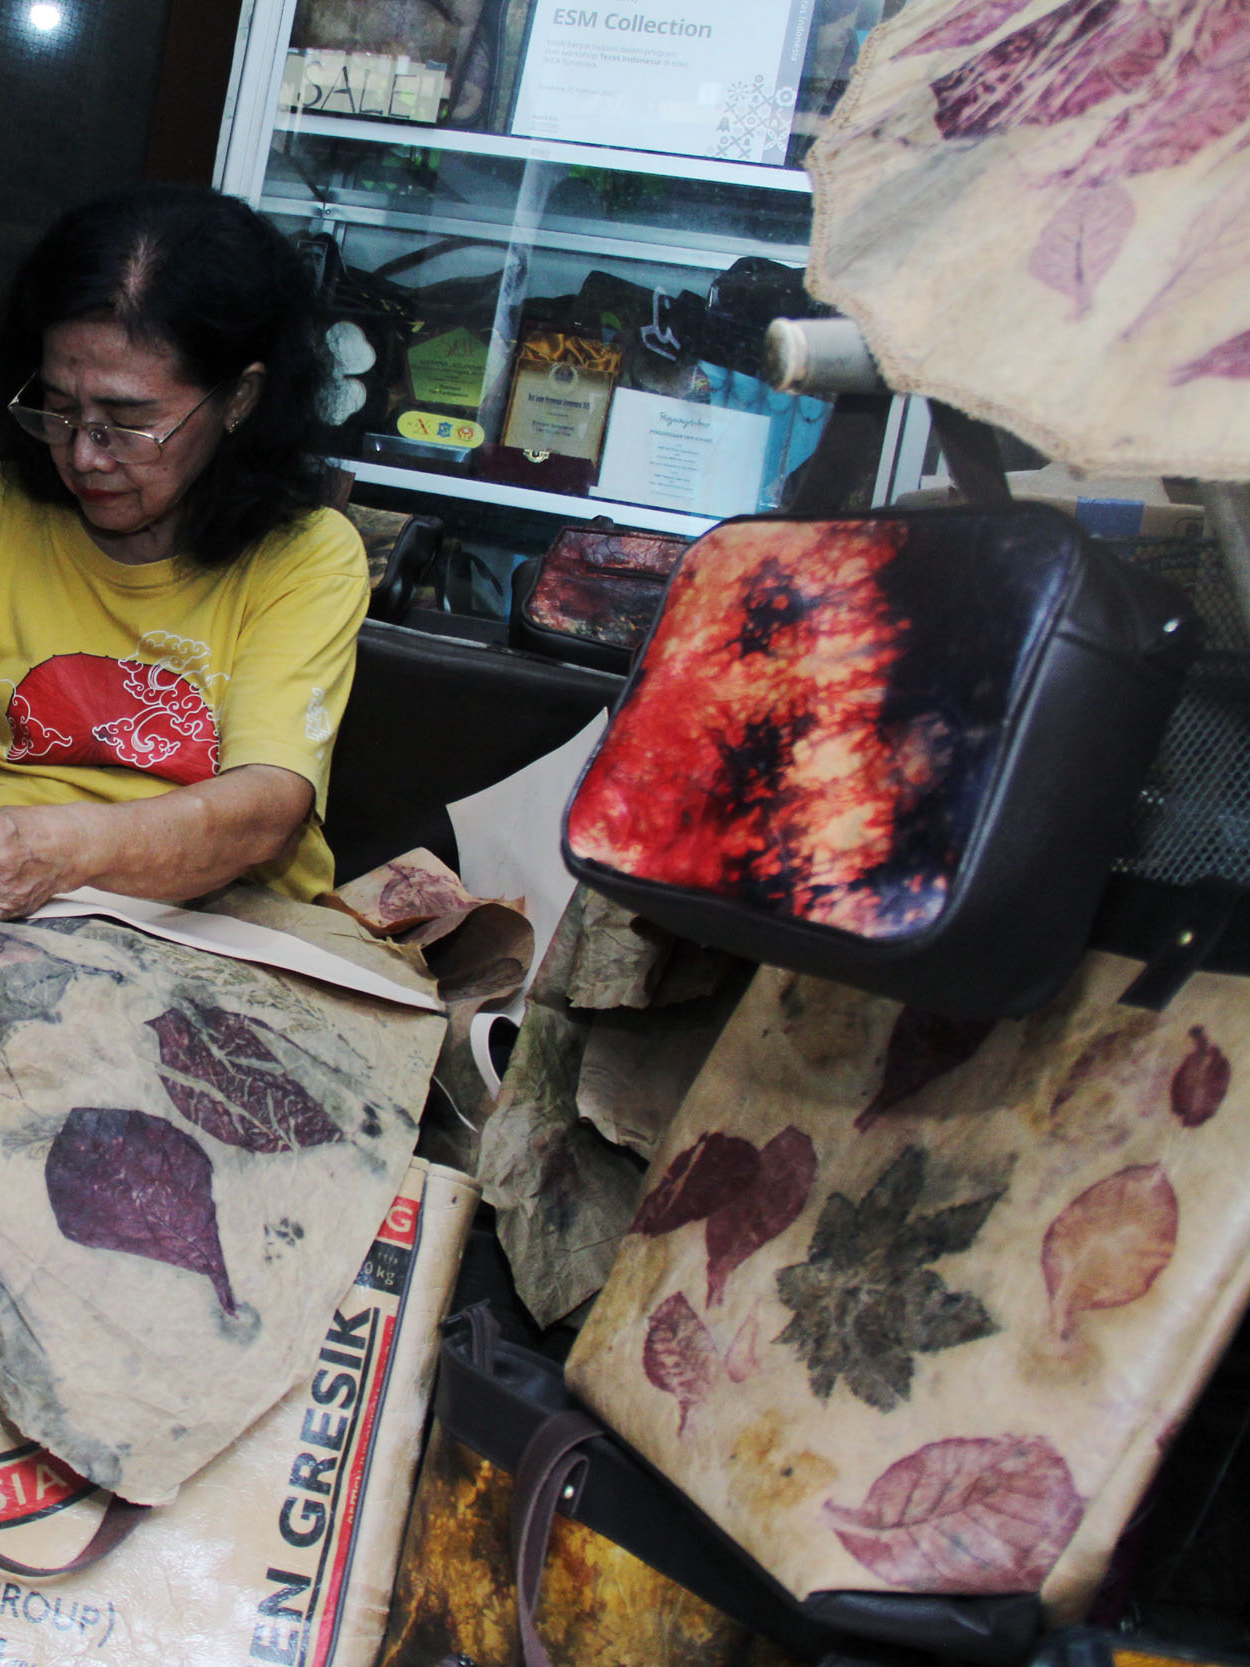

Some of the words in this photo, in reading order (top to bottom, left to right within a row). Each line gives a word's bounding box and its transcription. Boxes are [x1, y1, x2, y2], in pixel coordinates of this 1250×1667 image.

[552, 8, 598, 28] ESM
[604, 12, 712, 38] Collection
[297, 60, 418, 119] SALE
[279, 1307, 372, 1548] GRESIK
